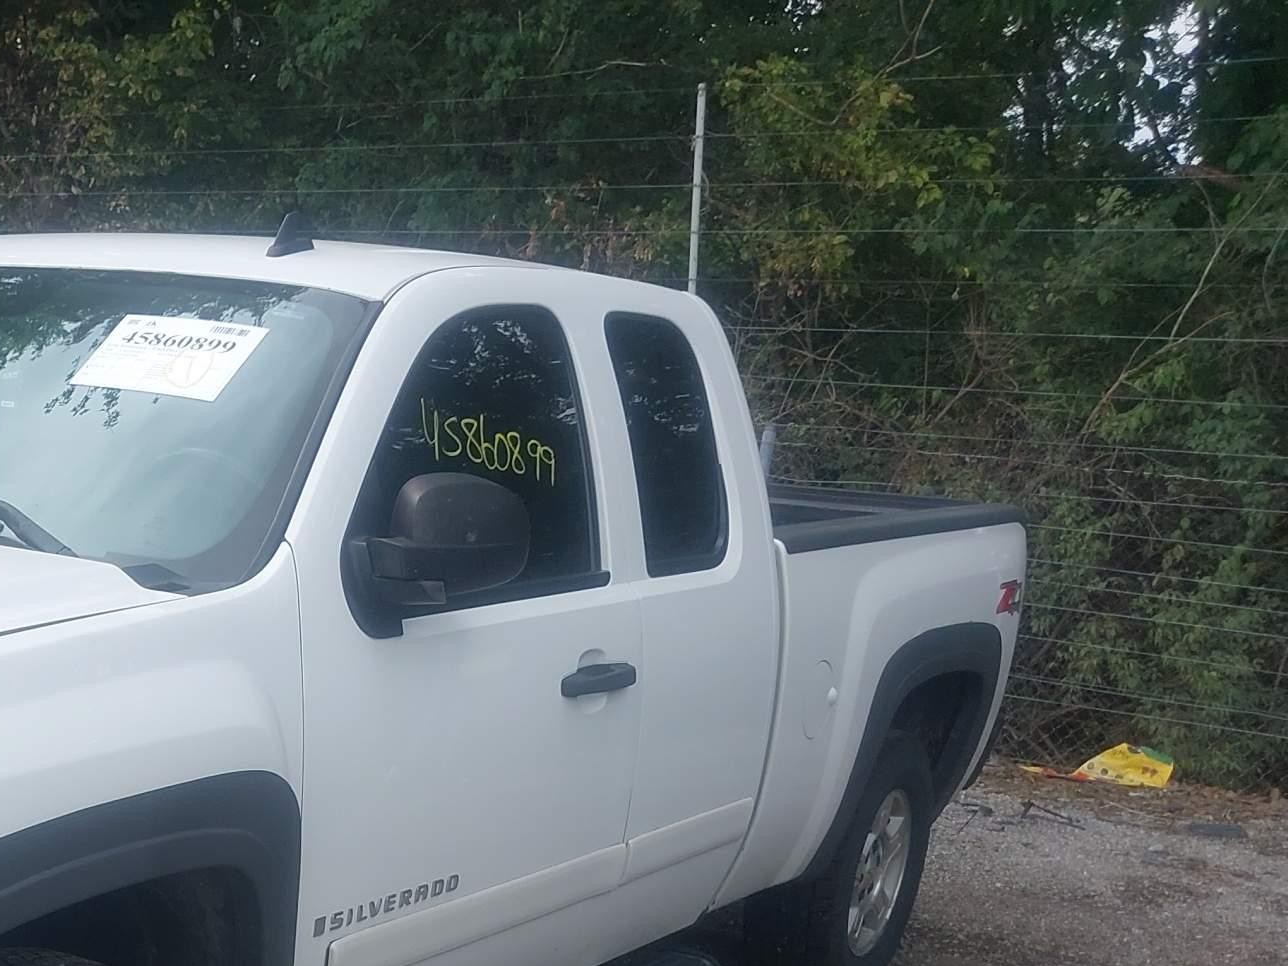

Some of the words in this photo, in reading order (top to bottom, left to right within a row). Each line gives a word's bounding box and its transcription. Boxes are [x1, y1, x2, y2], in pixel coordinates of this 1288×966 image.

[122, 331, 237, 354] 45860899
[421, 397, 556, 488] 45860899
[329, 873, 460, 932] SILVERADO
